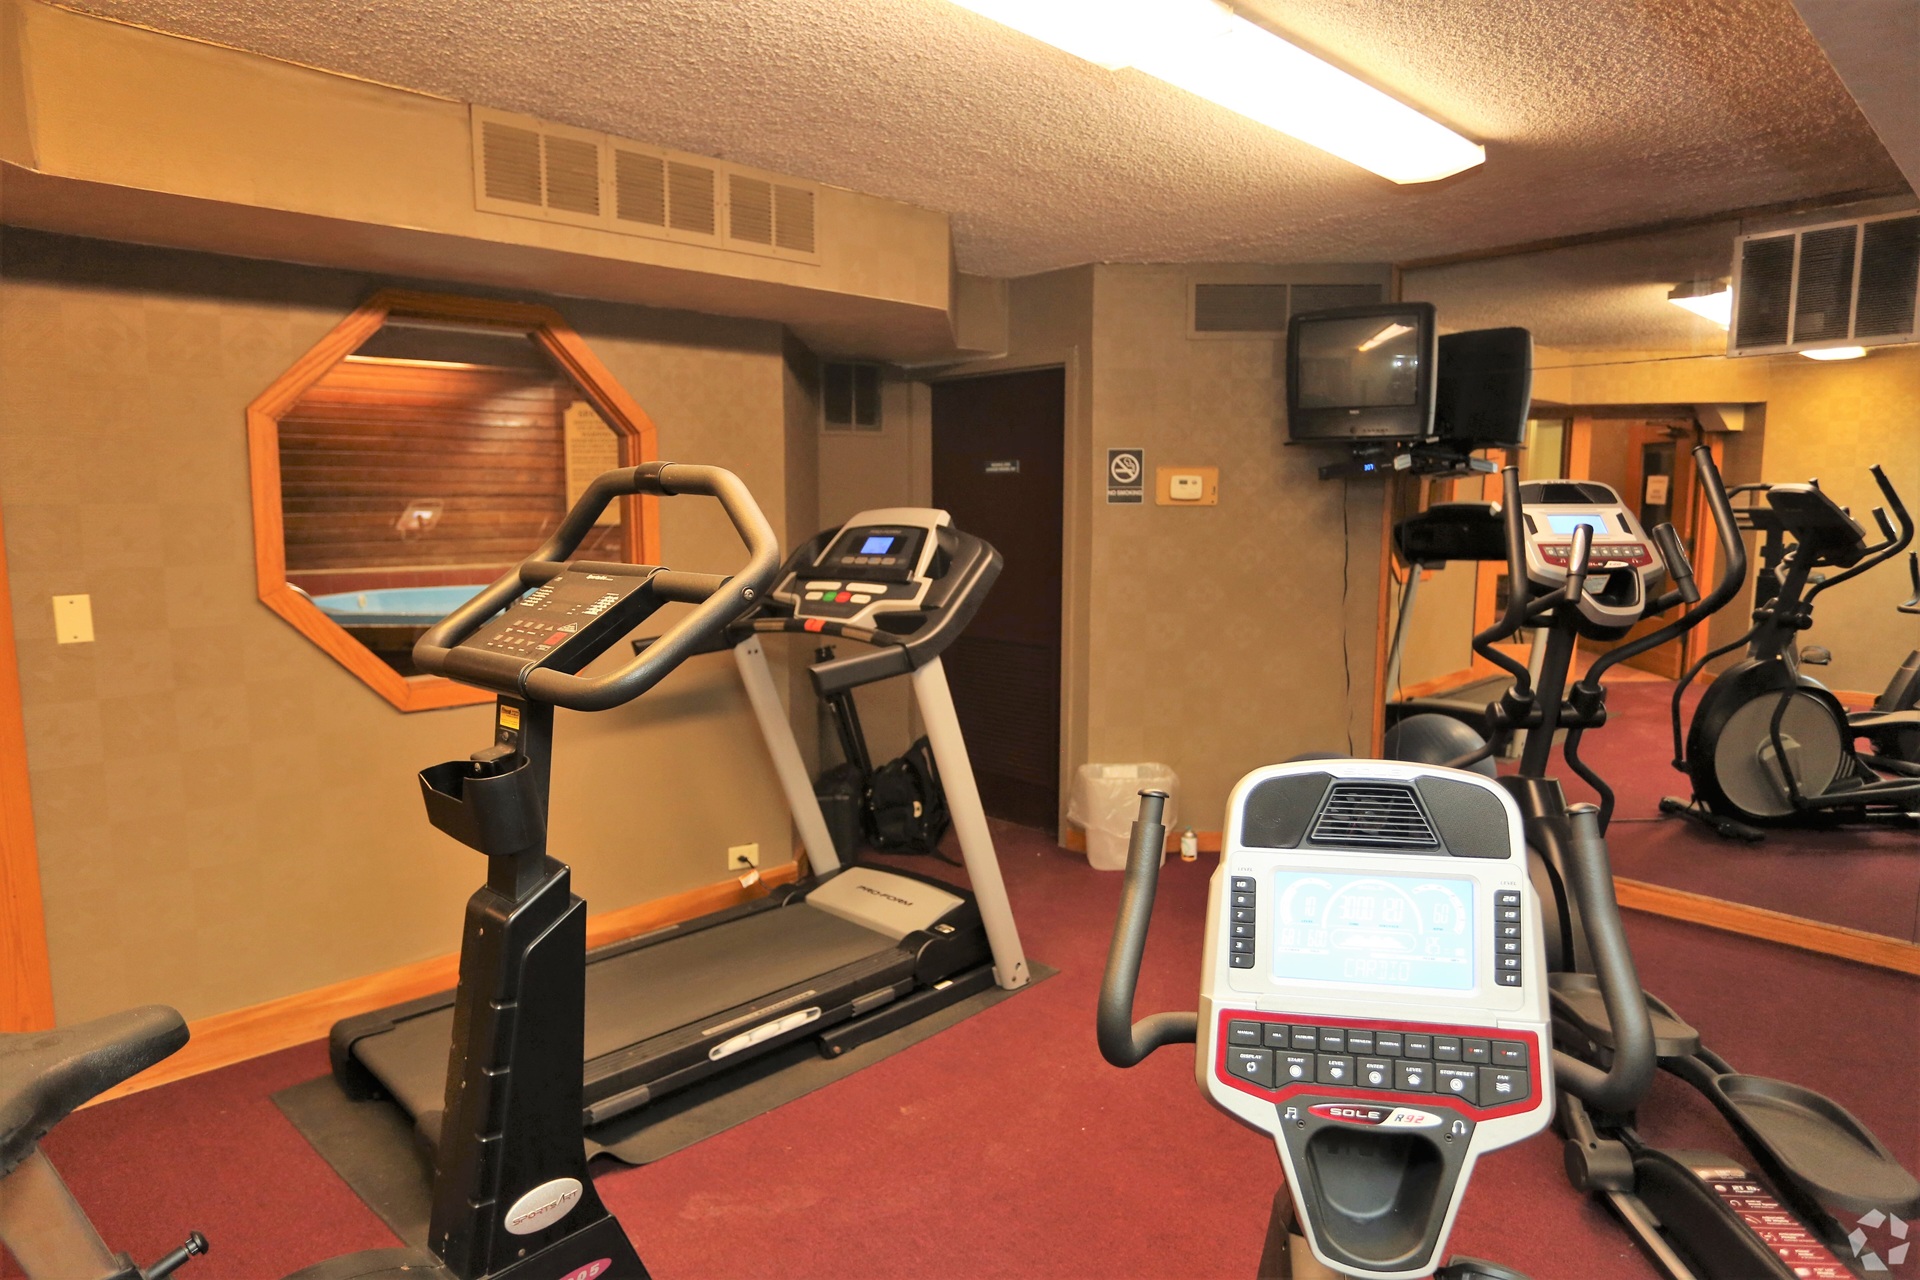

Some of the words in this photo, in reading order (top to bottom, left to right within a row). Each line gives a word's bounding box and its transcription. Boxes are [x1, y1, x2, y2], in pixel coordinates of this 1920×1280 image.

[1236, 926, 1243, 934] 5
[1504, 958, 1516, 966] 13
[1343, 958, 1410, 981] CARDIO
[1440, 1069, 1474, 1077] STOP/RESET
[1330, 1107, 1380, 1119] SOLE
[1394, 1114, 1425, 1124] R92
[566, 1262, 600, 1280] 05
